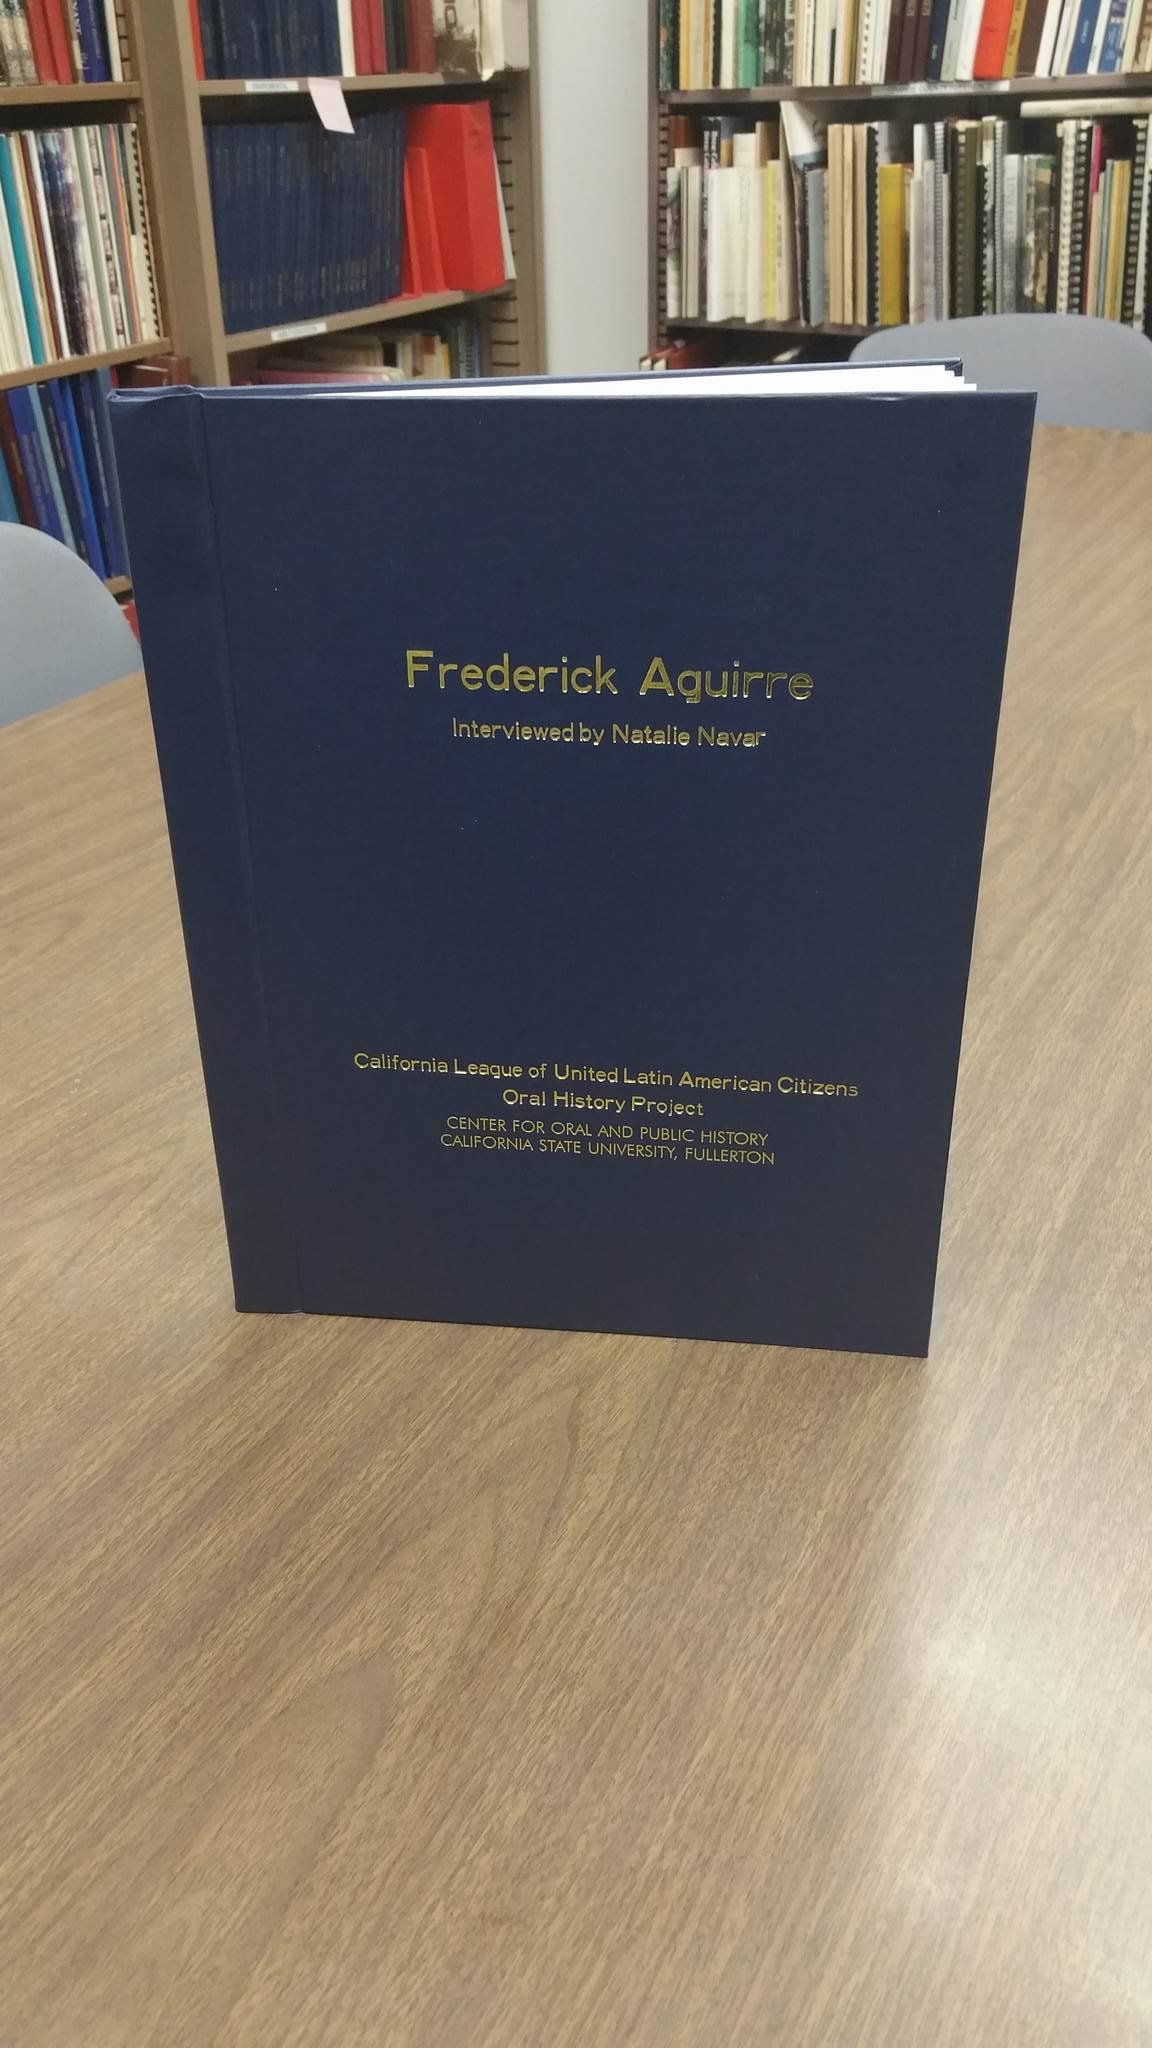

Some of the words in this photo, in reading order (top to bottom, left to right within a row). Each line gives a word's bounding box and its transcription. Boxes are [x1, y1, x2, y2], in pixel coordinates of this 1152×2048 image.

[405, 649, 619, 695] Frederick
[638, 656, 814, 704] Aguirre
[452, 716, 575, 743] Interviewed
[578, 721, 605, 746] by
[612, 723, 691, 747] Natalie
[697, 725, 767, 749] Navar
[353, 1052, 449, 1073] California
[453, 1058, 523, 1080] League
[527, 1062, 548, 1079] of
[554, 1063, 619, 1084] United
[623, 1067, 673, 1087] Latin
[677, 1071, 772, 1093] American
[777, 1076, 859, 1097] Citizens
[502, 1088, 546, 1107] Oral
[553, 1090, 627, 1114] History
[631, 1095, 705, 1117] Project
[446, 1115, 508, 1133] CENTER
[512, 1119, 546, 1135] FOR
[550, 1121, 593, 1137] ORAL
[597, 1124, 634, 1139] AND
[640, 1126, 695, 1143] PUBLIC
[700, 1128, 769, 1147] HISTORY
[440, 1133, 534, 1152] CALIFORNIA
[538, 1138, 583, 1155] STATE
[588, 1141, 678, 1161] UNIVERSITY,
[684, 1146, 775, 1166] FULLERTON
